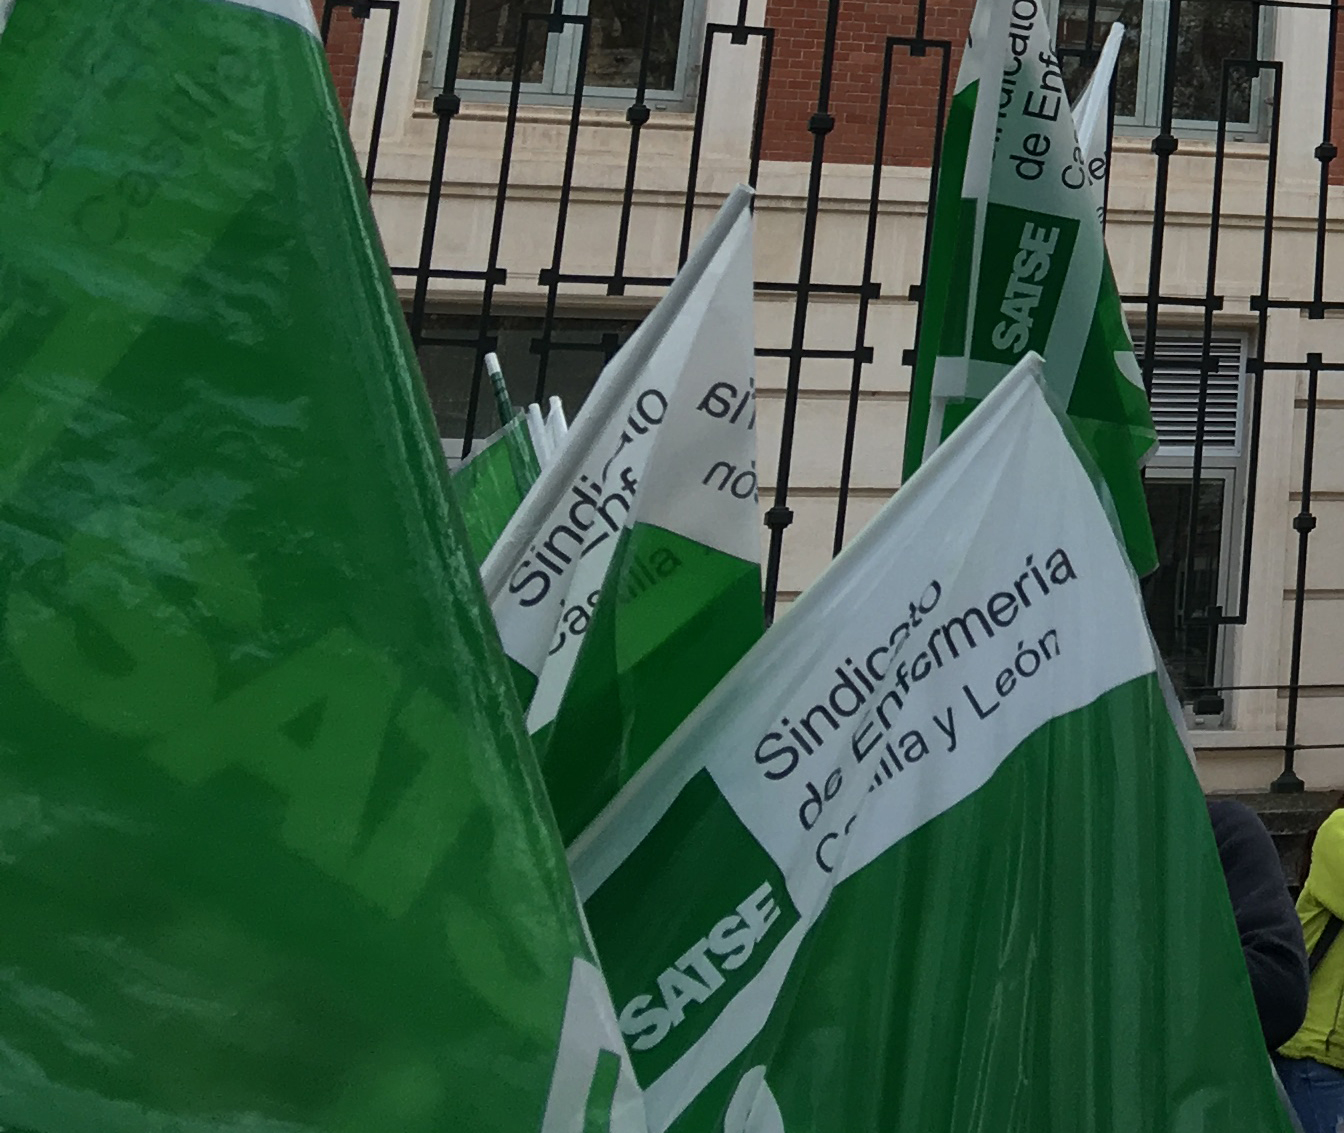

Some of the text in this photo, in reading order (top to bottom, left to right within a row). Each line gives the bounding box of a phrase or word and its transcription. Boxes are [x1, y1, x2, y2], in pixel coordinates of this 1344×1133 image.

[1010, 39, 1064, 181] de Enf
[992, 222, 1060, 355] SATSE
[932, 705, 959, 753] y
[962, 628, 1062, 721] León
[620, 881, 782, 1050] SATSE
